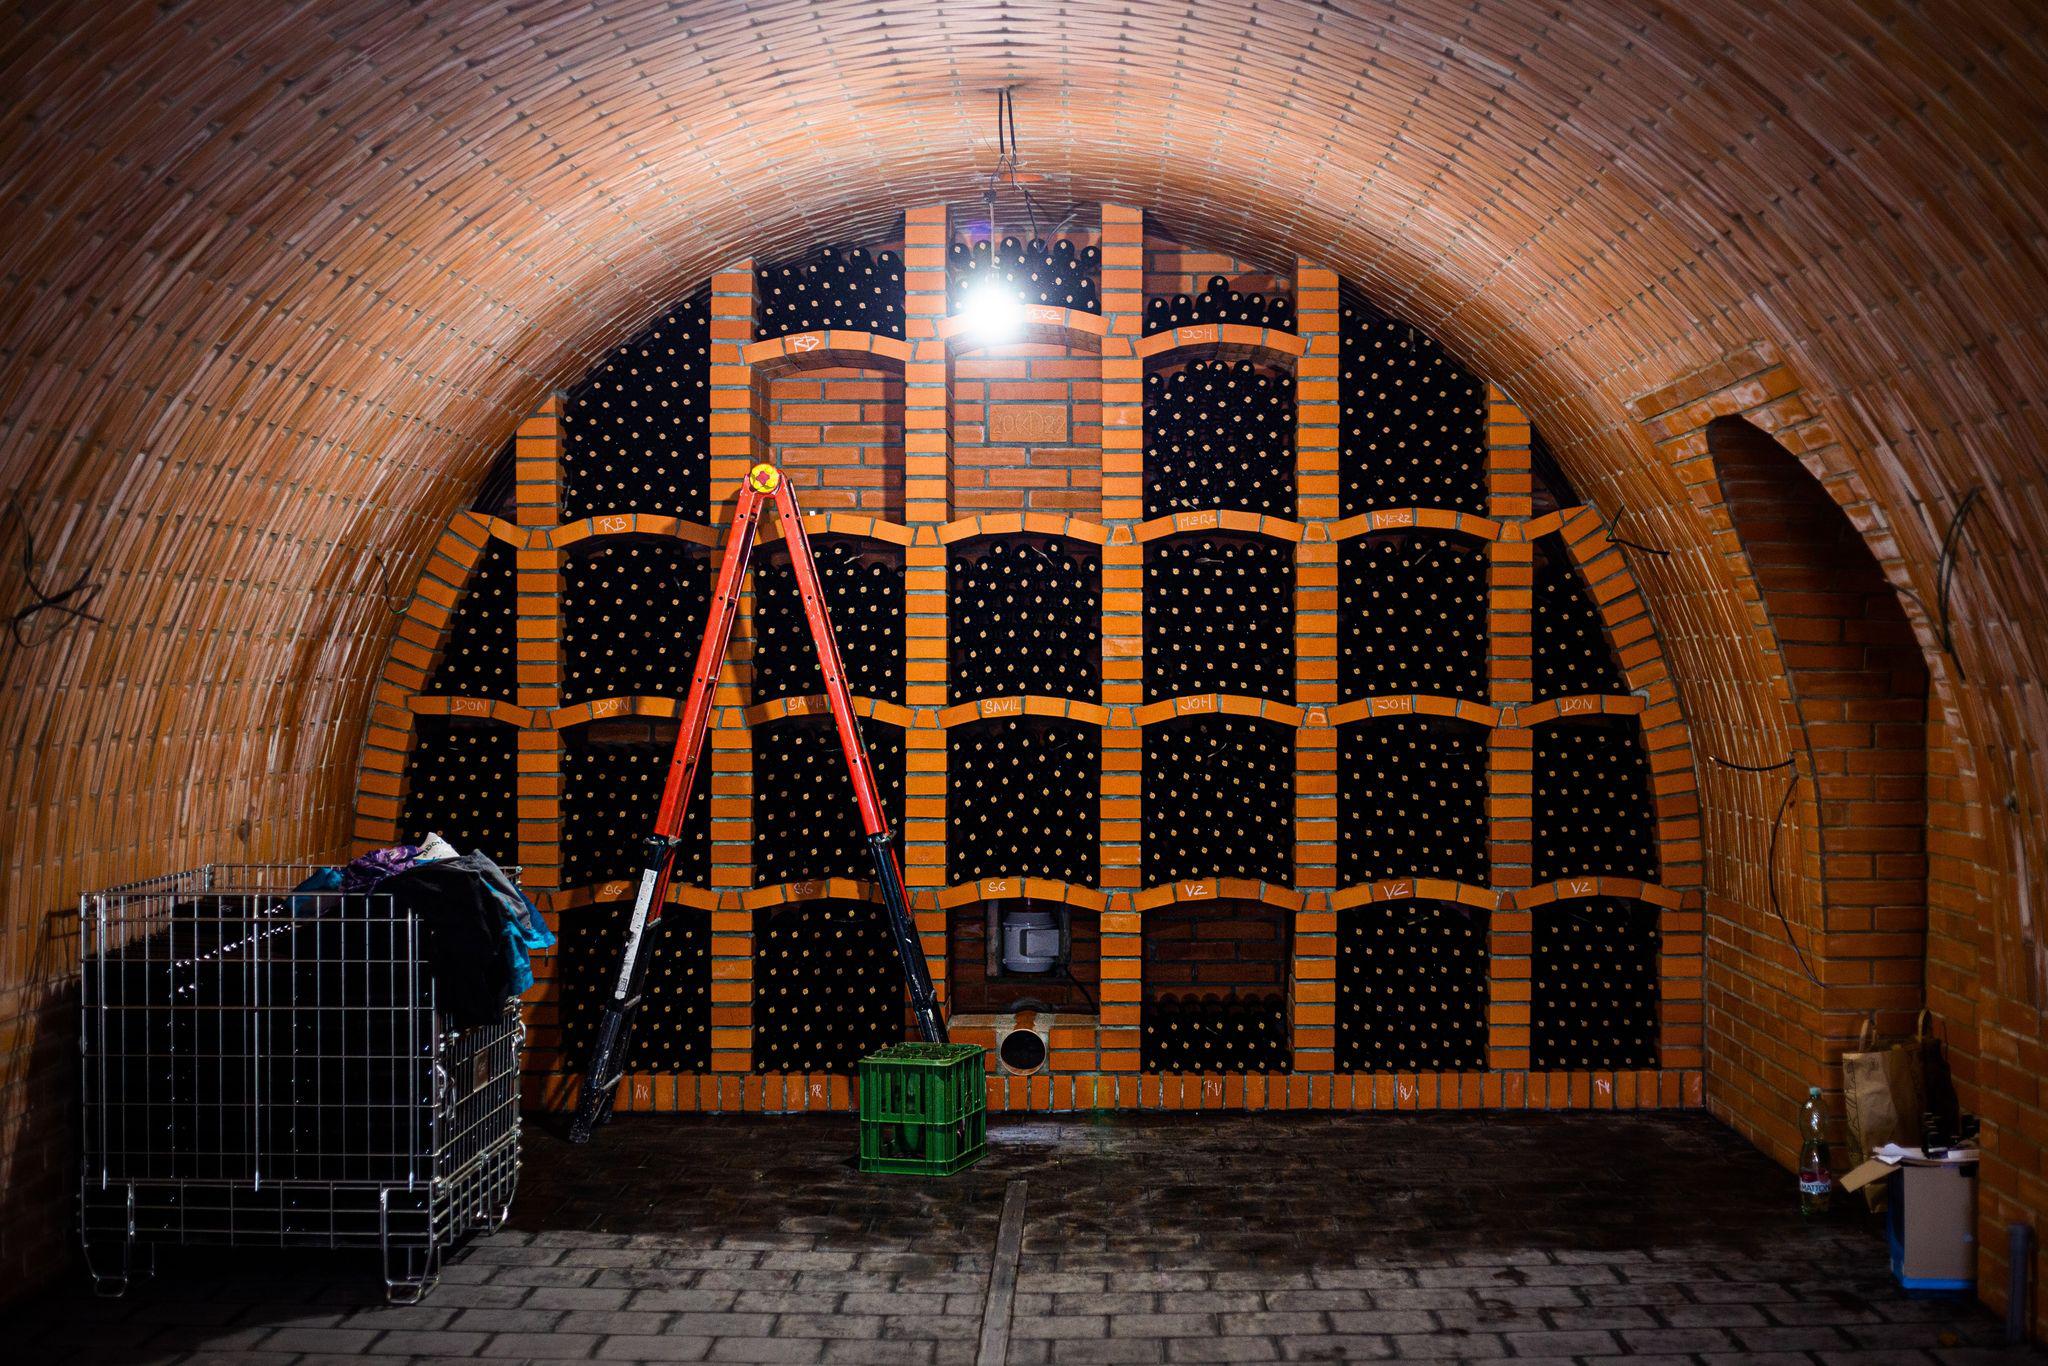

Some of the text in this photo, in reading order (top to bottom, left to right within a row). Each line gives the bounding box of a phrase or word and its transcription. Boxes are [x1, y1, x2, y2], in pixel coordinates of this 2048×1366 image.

[785, 335, 820, 353] RB
[599, 517, 627, 533] RB
[452, 699, 487, 712] DON
[596, 697, 629, 715] DON
[984, 699, 1021, 714] SAVIL
[1180, 694, 1212, 711] JOH
[1376, 699, 1410, 711] JOH
